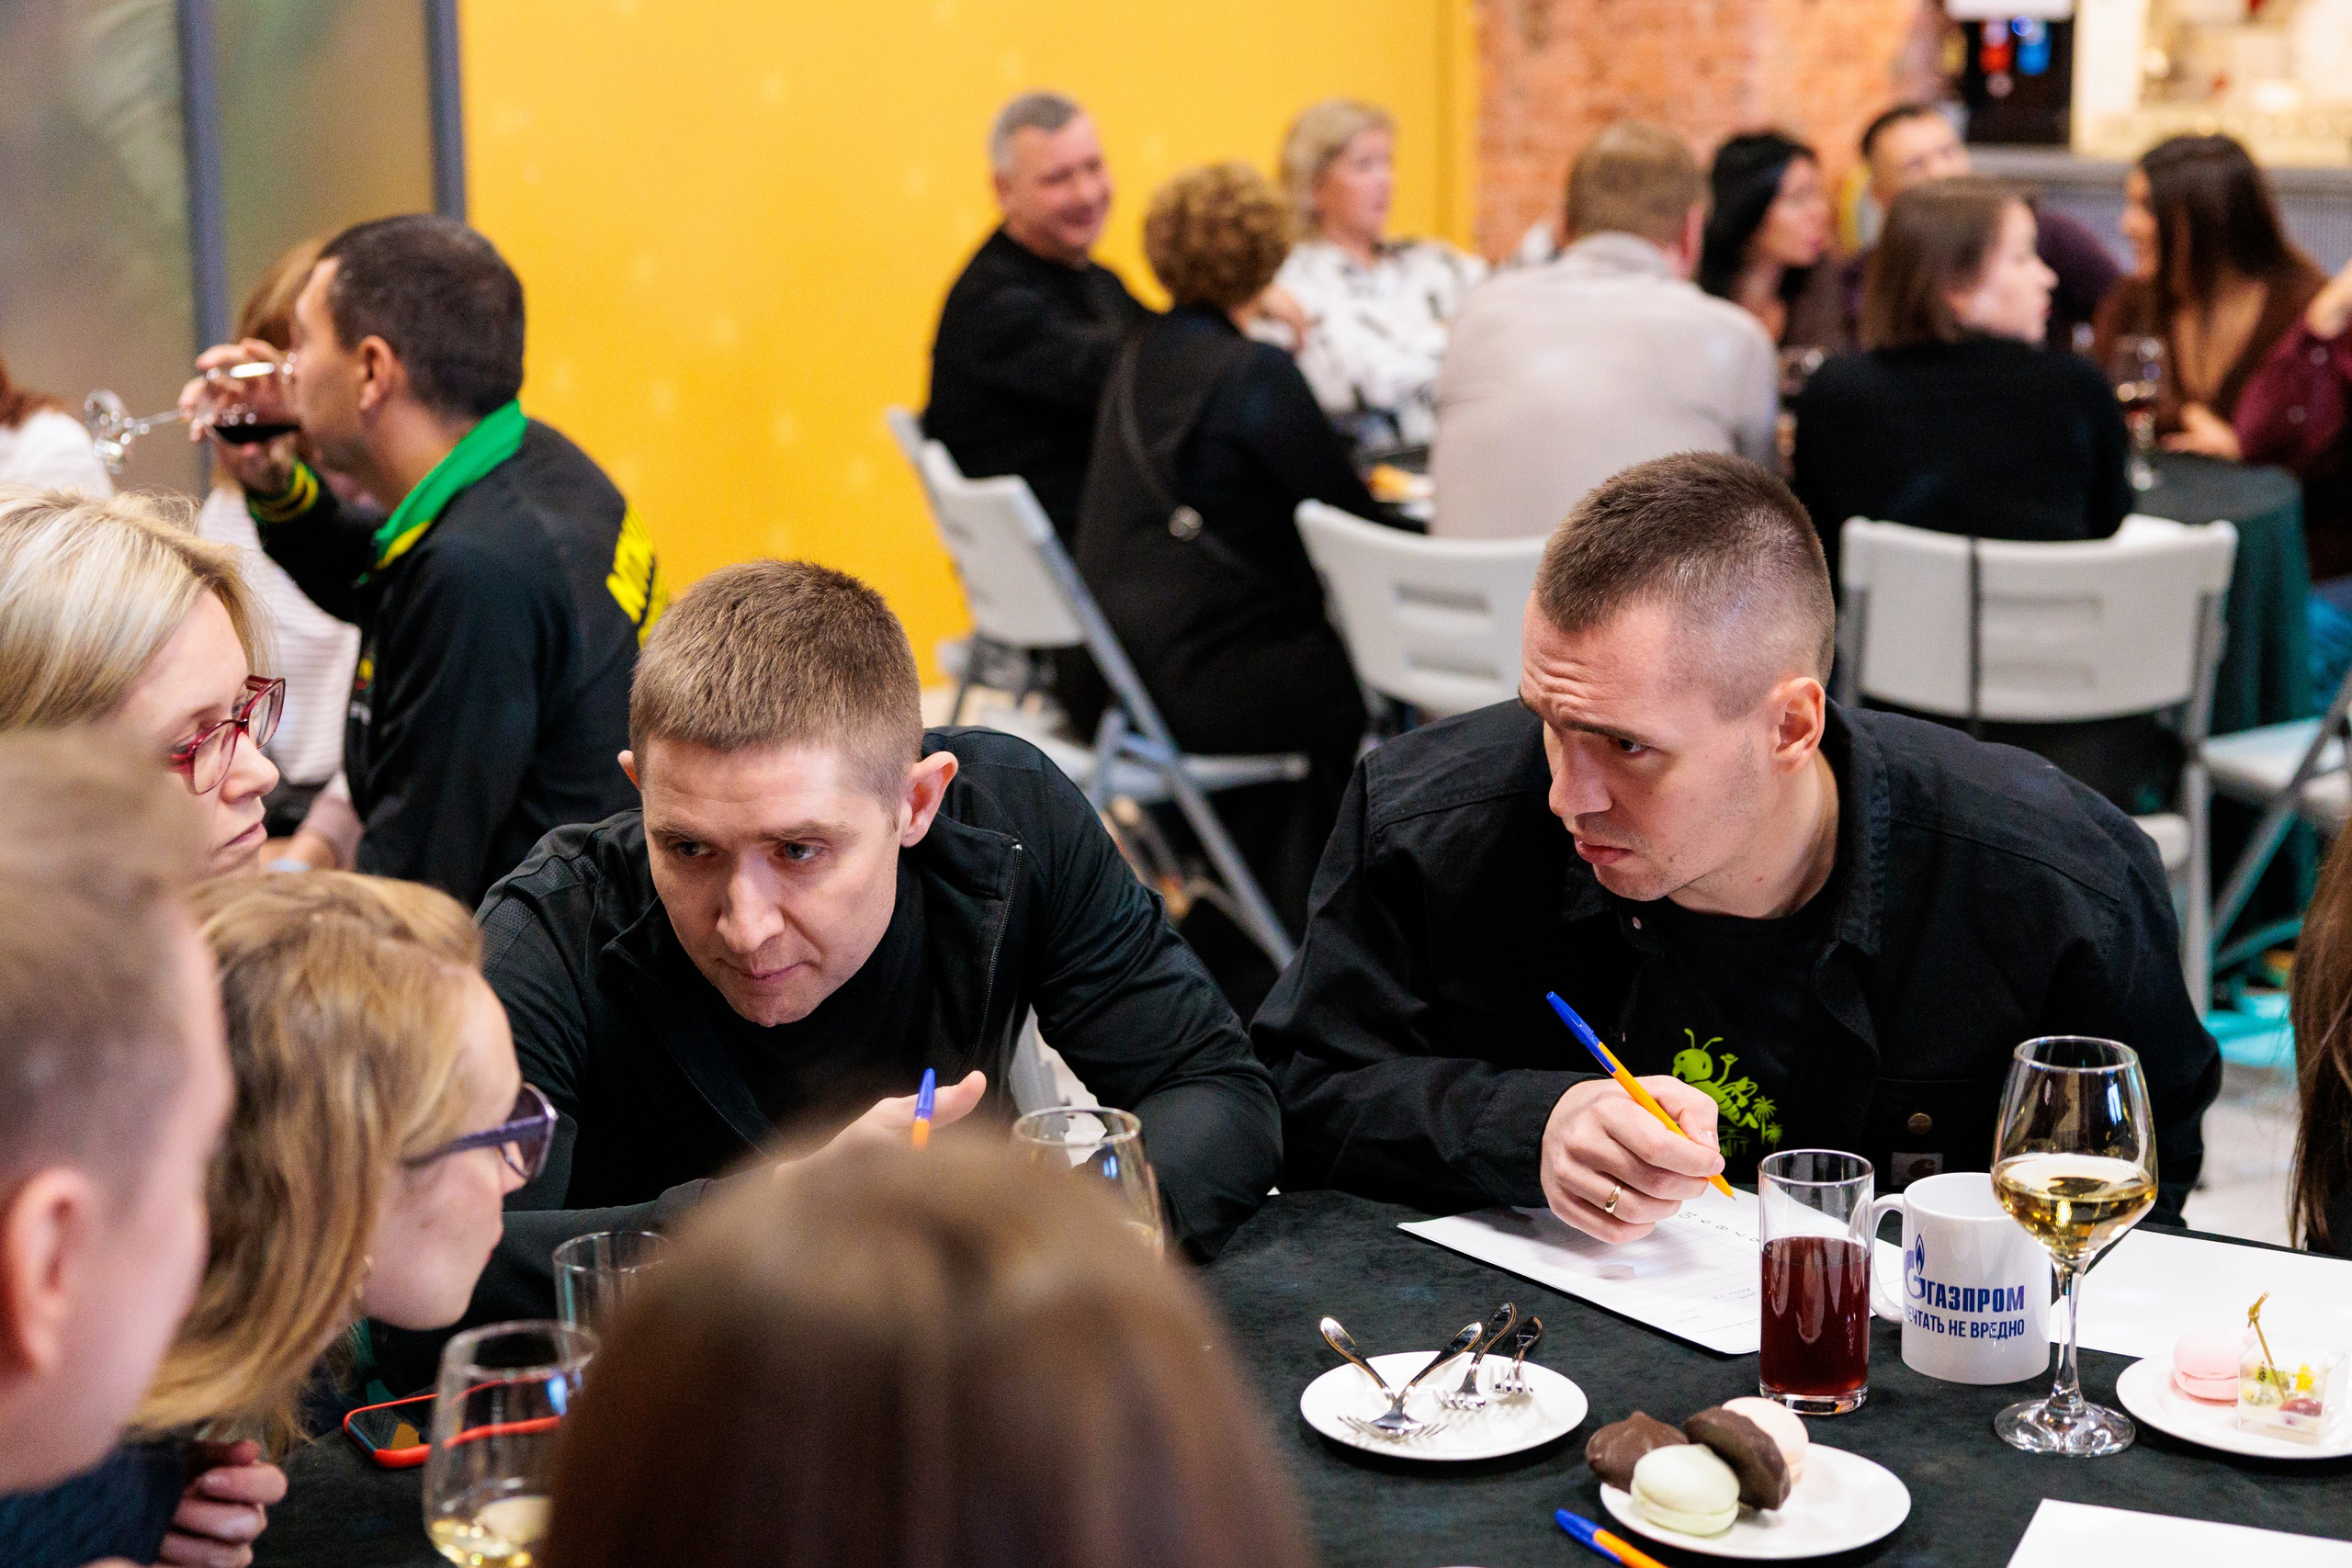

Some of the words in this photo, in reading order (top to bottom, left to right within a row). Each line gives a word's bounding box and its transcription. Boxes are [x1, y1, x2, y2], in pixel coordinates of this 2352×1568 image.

[1927, 1280, 2025, 1314] ГАЗПРОМ
[1949, 1319, 1966, 1337] НЕ
[1970, 1318, 2025, 1340] ВРЕДНО
